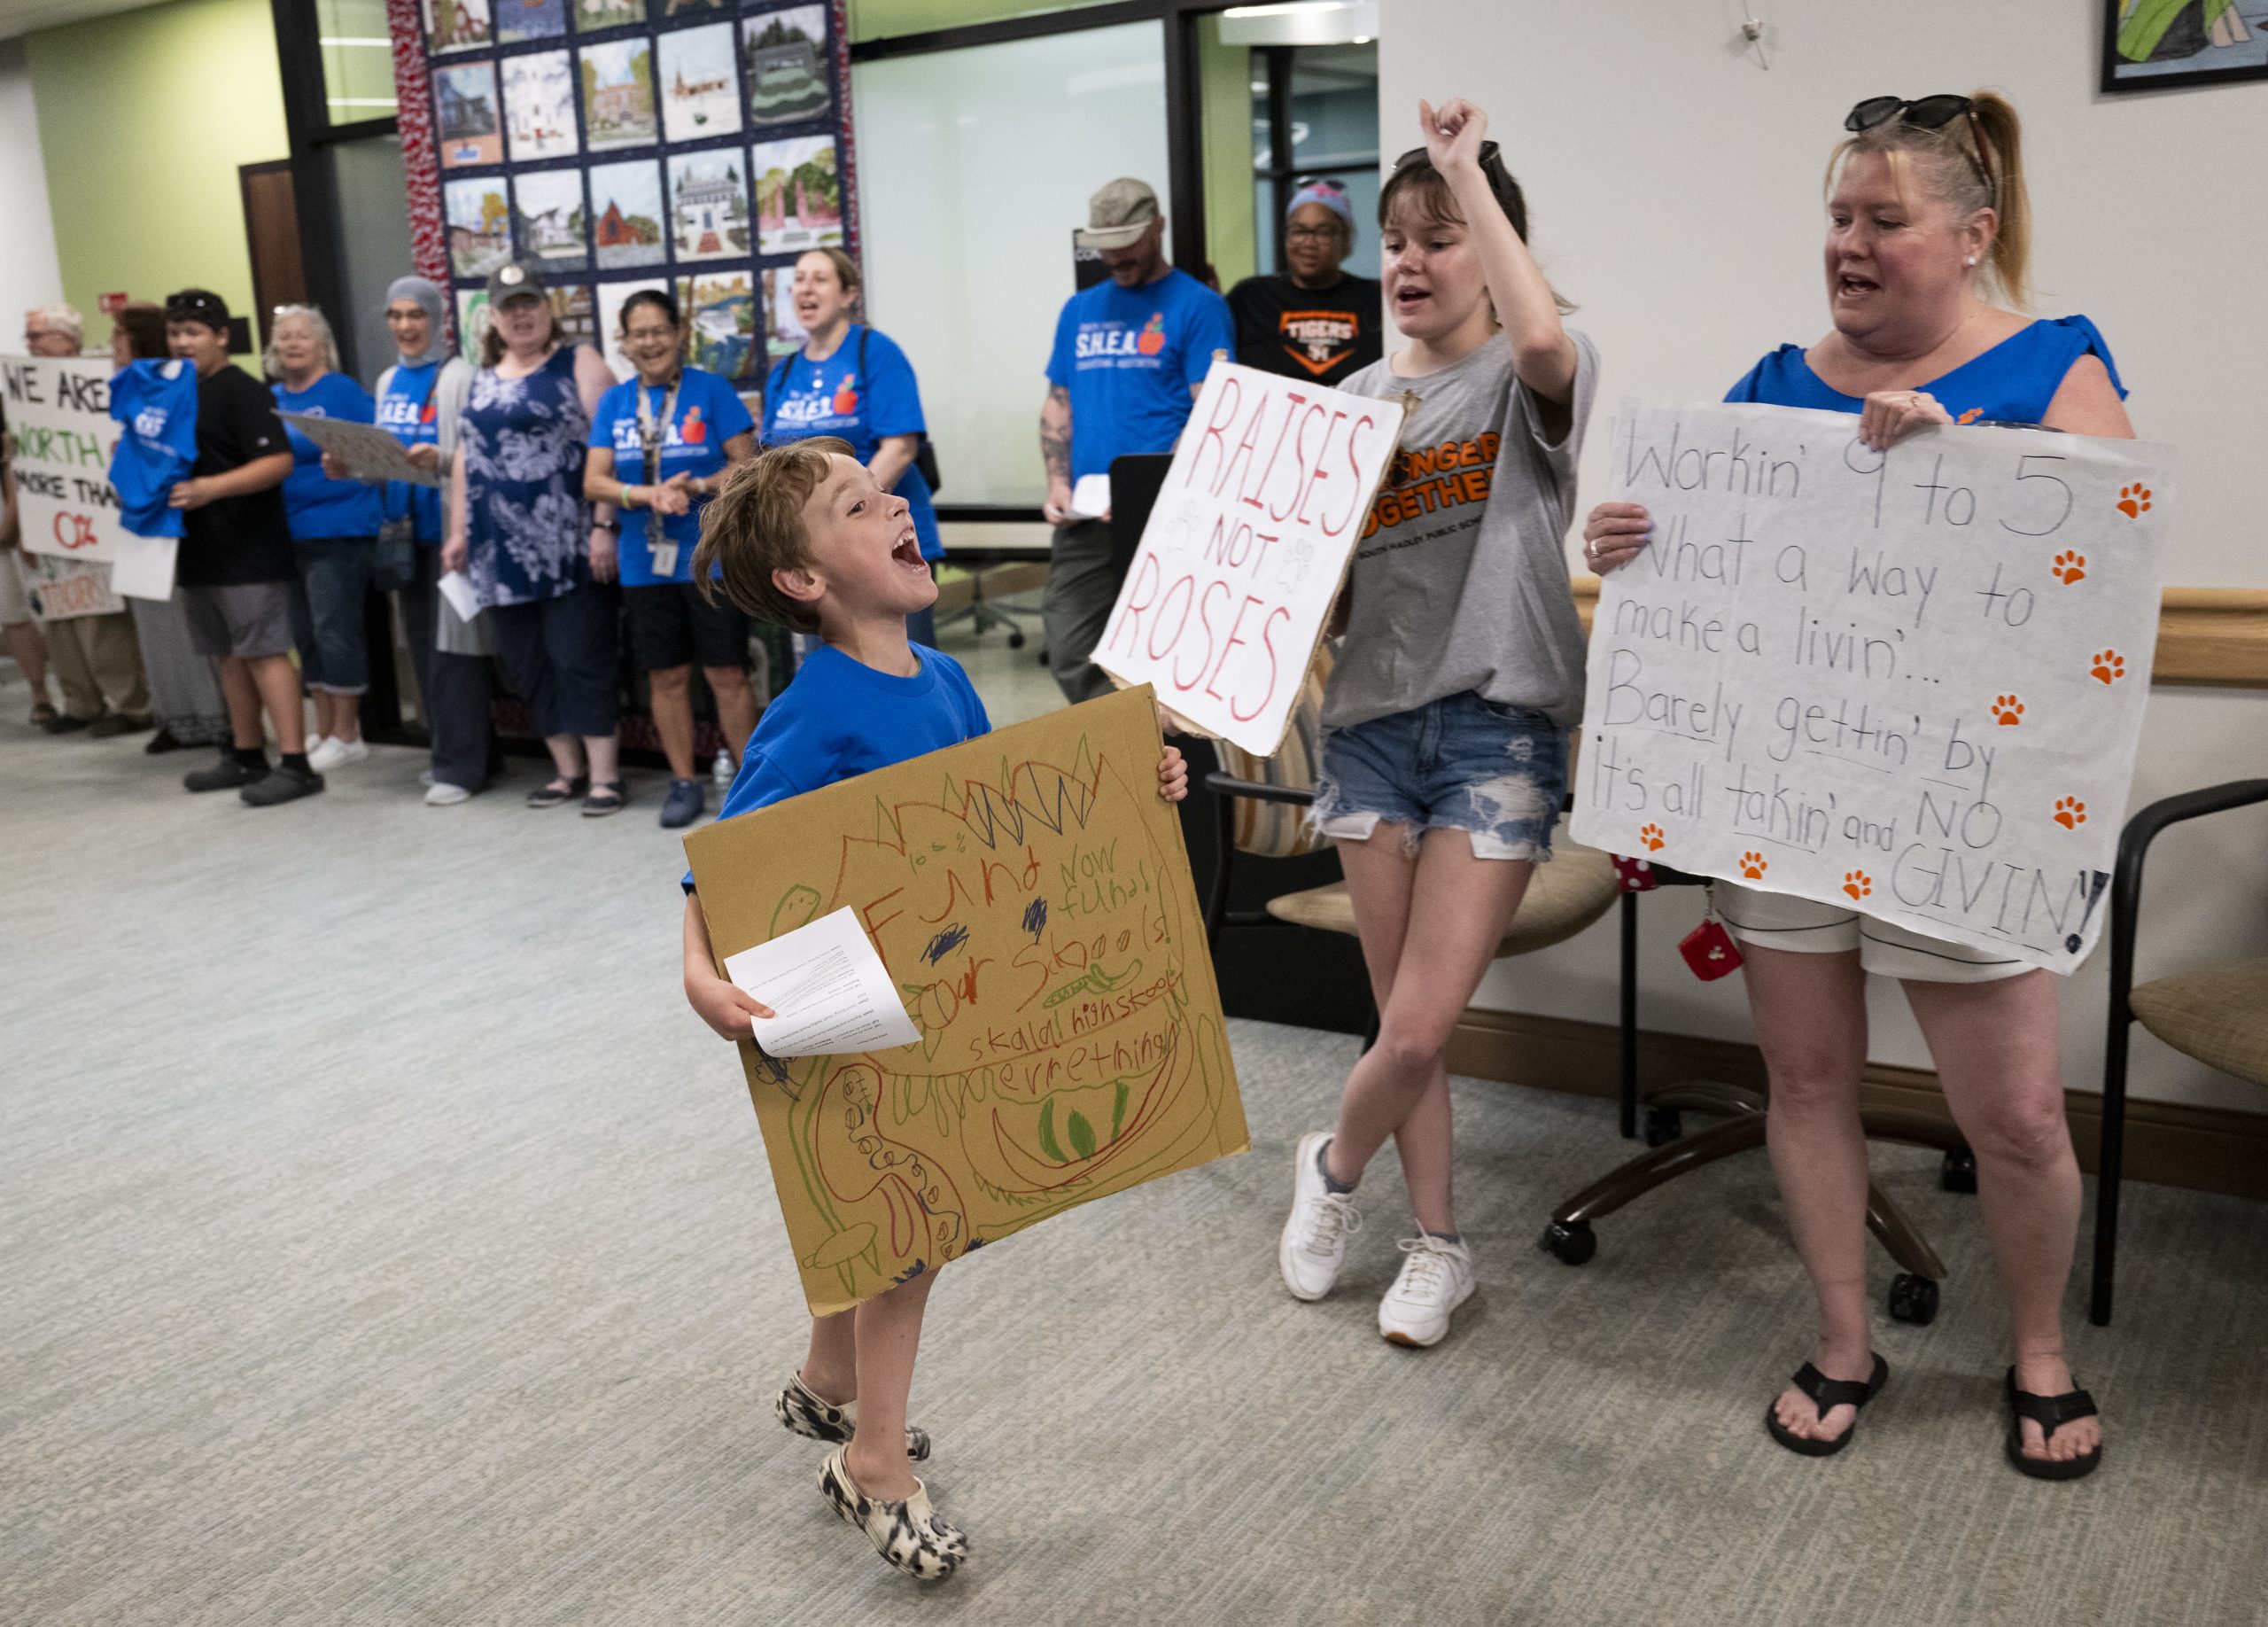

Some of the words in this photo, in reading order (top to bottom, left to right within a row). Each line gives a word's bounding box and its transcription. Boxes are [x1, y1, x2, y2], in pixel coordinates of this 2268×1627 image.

[1286, 320, 1353, 339] TIGERS
[4, 362, 44, 404] WE
[58, 370, 110, 414] ARE
[1185, 378, 1374, 537] RAISES
[1626, 418, 1806, 498] Workin'
[1844, 436, 1887, 528] 9
[1913, 453, 1976, 525] to
[1998, 455, 2073, 536] 5
[1204, 513, 1278, 579] NOT
[1775, 544, 1807, 592] a
[1976, 562, 2035, 627] to
[1108, 552, 1290, 722] ROSES
[1613, 598, 1724, 652] make
[1737, 622, 1761, 656] a
[1603, 649, 1744, 763] Barely
[1945, 718, 1996, 814] by
[1662, 762, 1705, 820] all
[1844, 812, 1898, 852] and
[1916, 790, 2003, 849] NO
